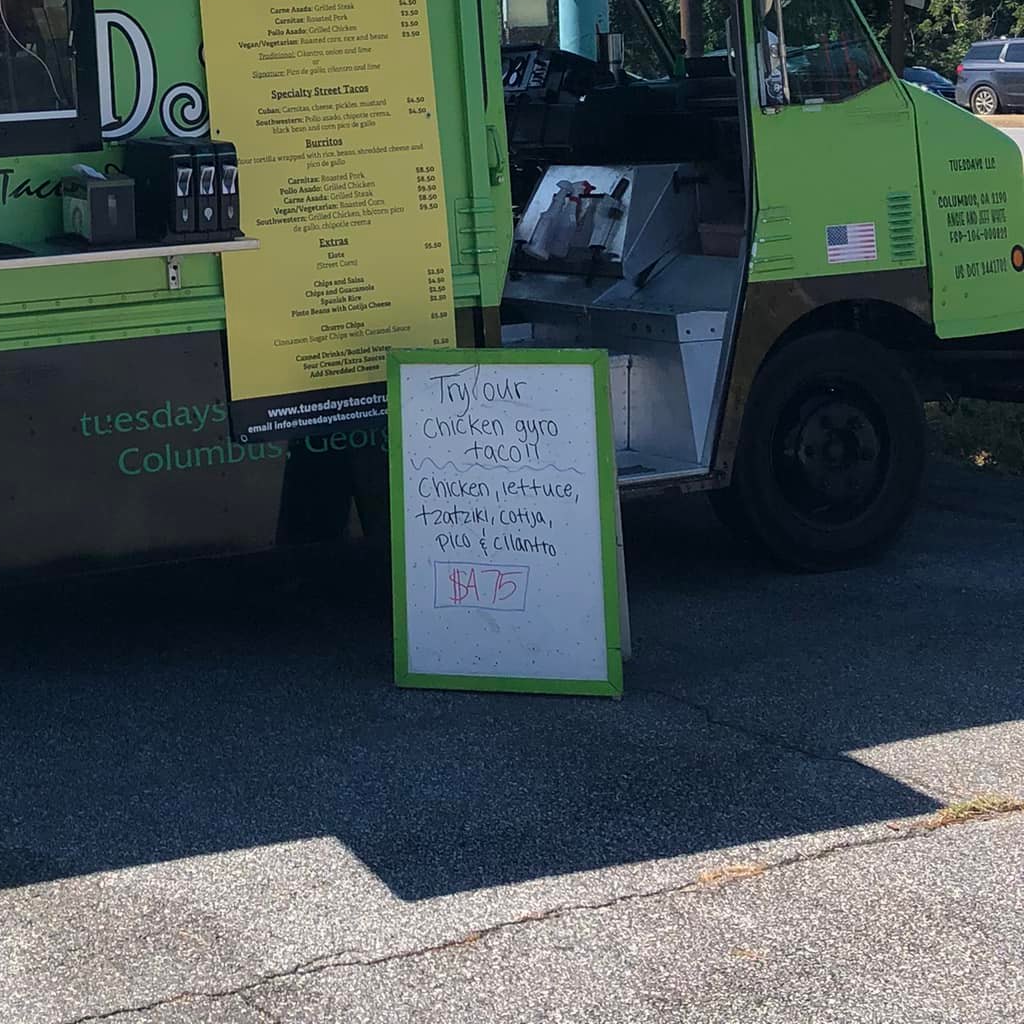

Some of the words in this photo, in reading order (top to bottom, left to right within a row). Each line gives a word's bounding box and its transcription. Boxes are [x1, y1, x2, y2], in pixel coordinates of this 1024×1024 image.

[272, 89, 311, 100] Specialty
[314, 87, 341, 96] Street
[343, 84, 368, 94] Tacos
[306, 138, 343, 148] Burritos
[949, 158, 983, 171] TUESDAYS
[985, 158, 995, 169] LLC
[938, 194, 979, 208] COLUMBUS,
[319, 238, 348, 248] Extras
[248, 421, 272, 433] email
[423, 416, 504, 439] Chicken
[516, 418, 558, 443] gyro
[493, 532, 556, 557] cilantro
